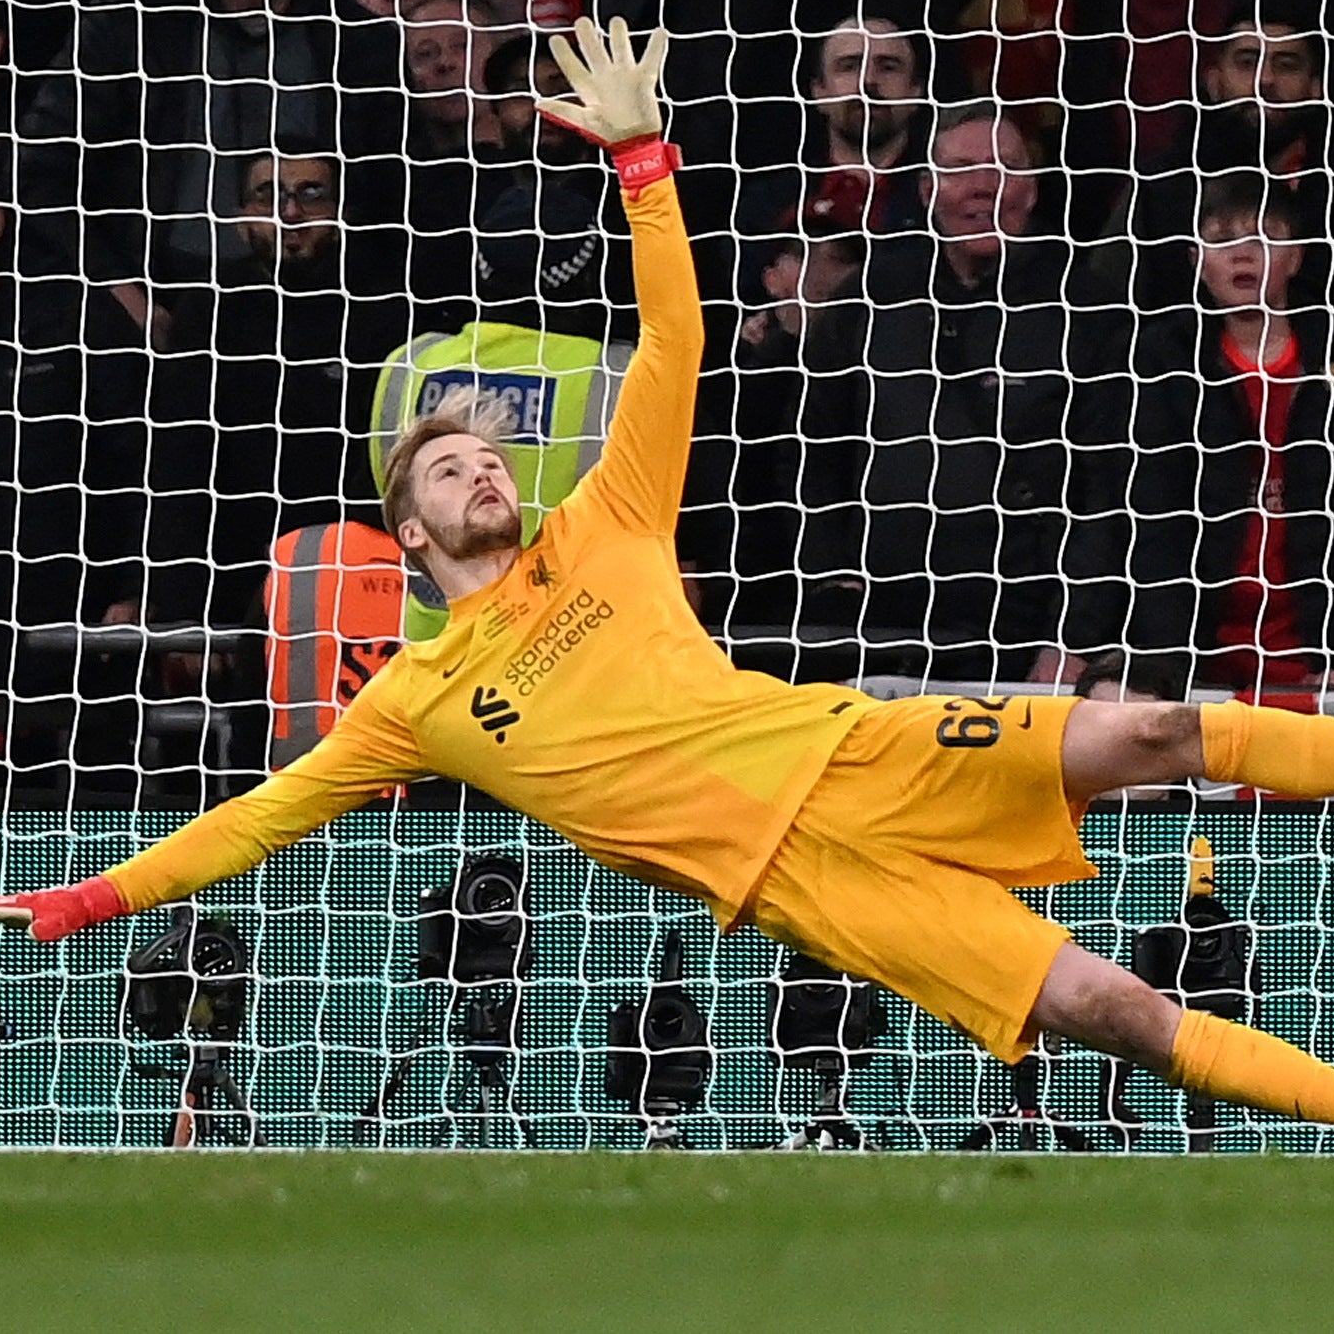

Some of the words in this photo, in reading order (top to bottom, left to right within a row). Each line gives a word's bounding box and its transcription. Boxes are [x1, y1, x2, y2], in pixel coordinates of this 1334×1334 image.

[339, 634, 403, 700] S
[504, 588, 595, 686] standard
[517, 599, 615, 698] chartered
